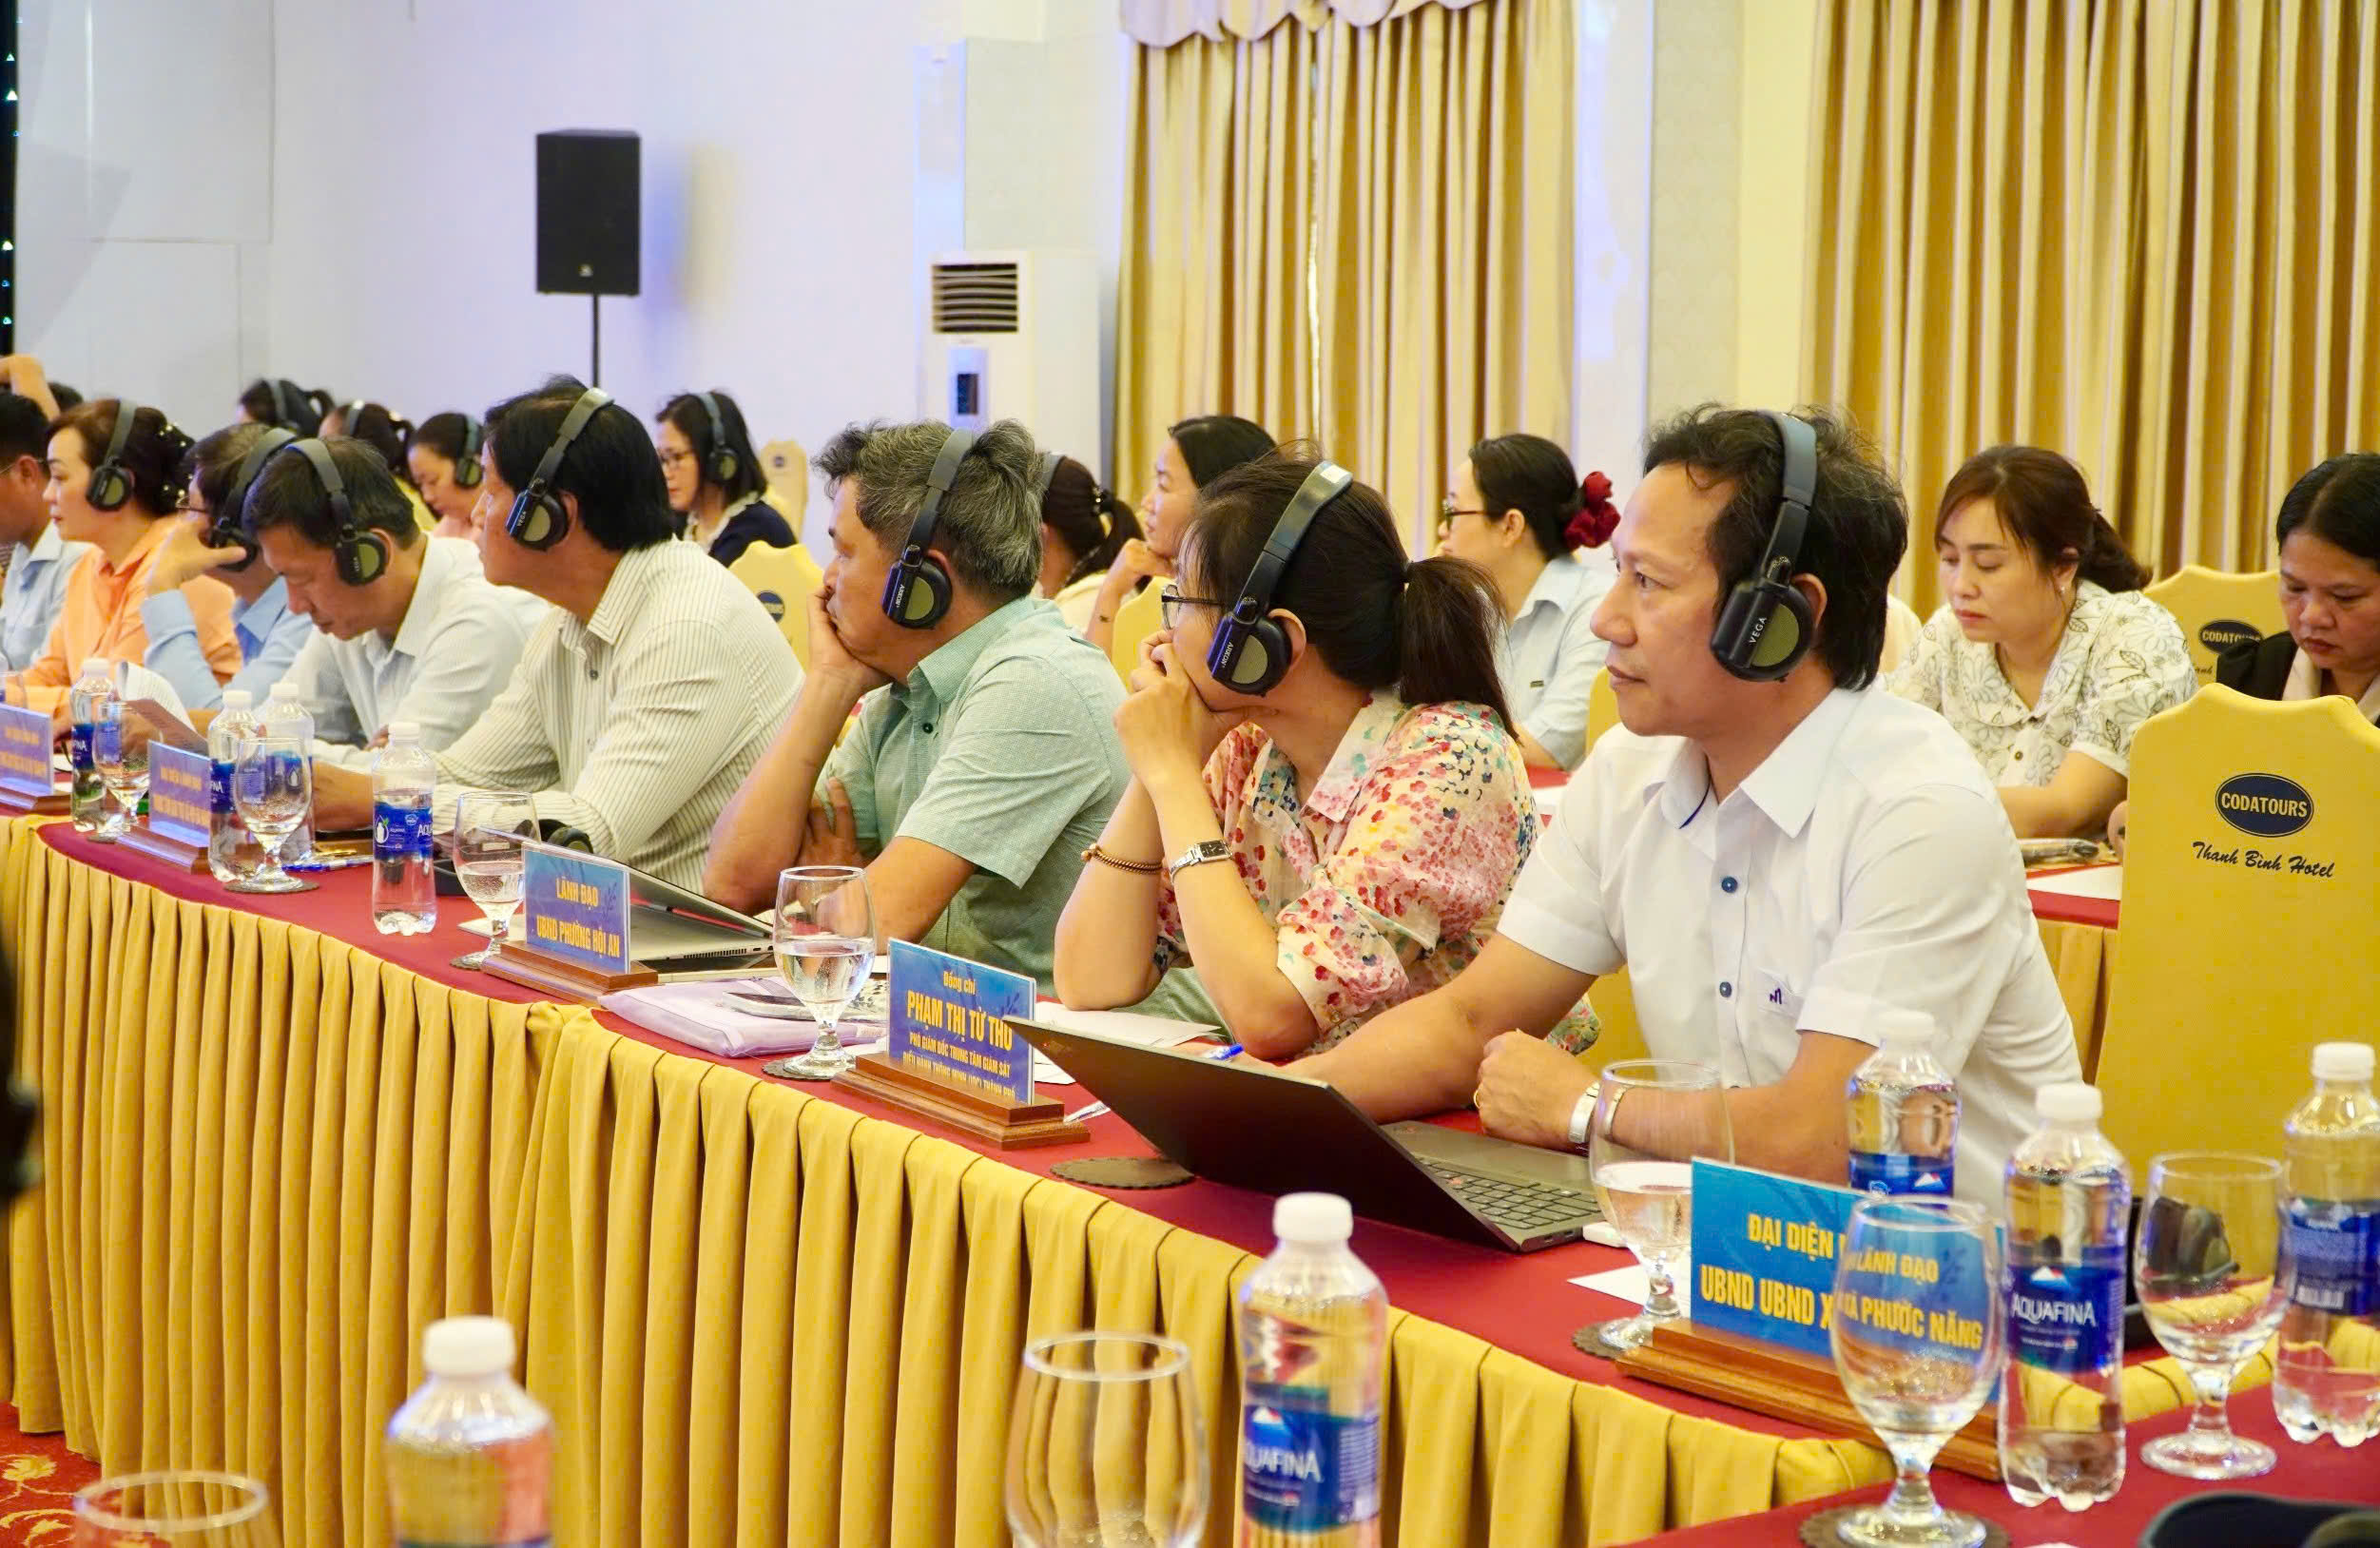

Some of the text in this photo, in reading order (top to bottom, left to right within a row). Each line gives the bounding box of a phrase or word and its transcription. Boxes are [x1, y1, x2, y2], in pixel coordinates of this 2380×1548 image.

[1749, 616, 1768, 644] VEGA
[2201, 629, 2260, 644] CODAT
[1220, 641, 1234, 668] ARKON
[2220, 792, 2309, 819] CODATOURS
[2192, 841, 2335, 879] Thanh Bình Hotel
[608, 933, 621, 958] AN
[907, 989, 943, 1031] PHẠM
[945, 1001, 966, 1043] THỊ
[1747, 1212, 1782, 1251] ĐẠI
[1786, 1221, 1835, 1261] DIỆN
[1900, 1254, 1939, 1286] ĐẠO
[1700, 1264, 1754, 1310] UBND
[1759, 1279, 1815, 1326] UBND
[1928, 1308, 1983, 1350] NĂNG
[2010, 1291, 2098, 1328] AQUAFINA
[1246, 1439, 1324, 1483] QUAFINA
